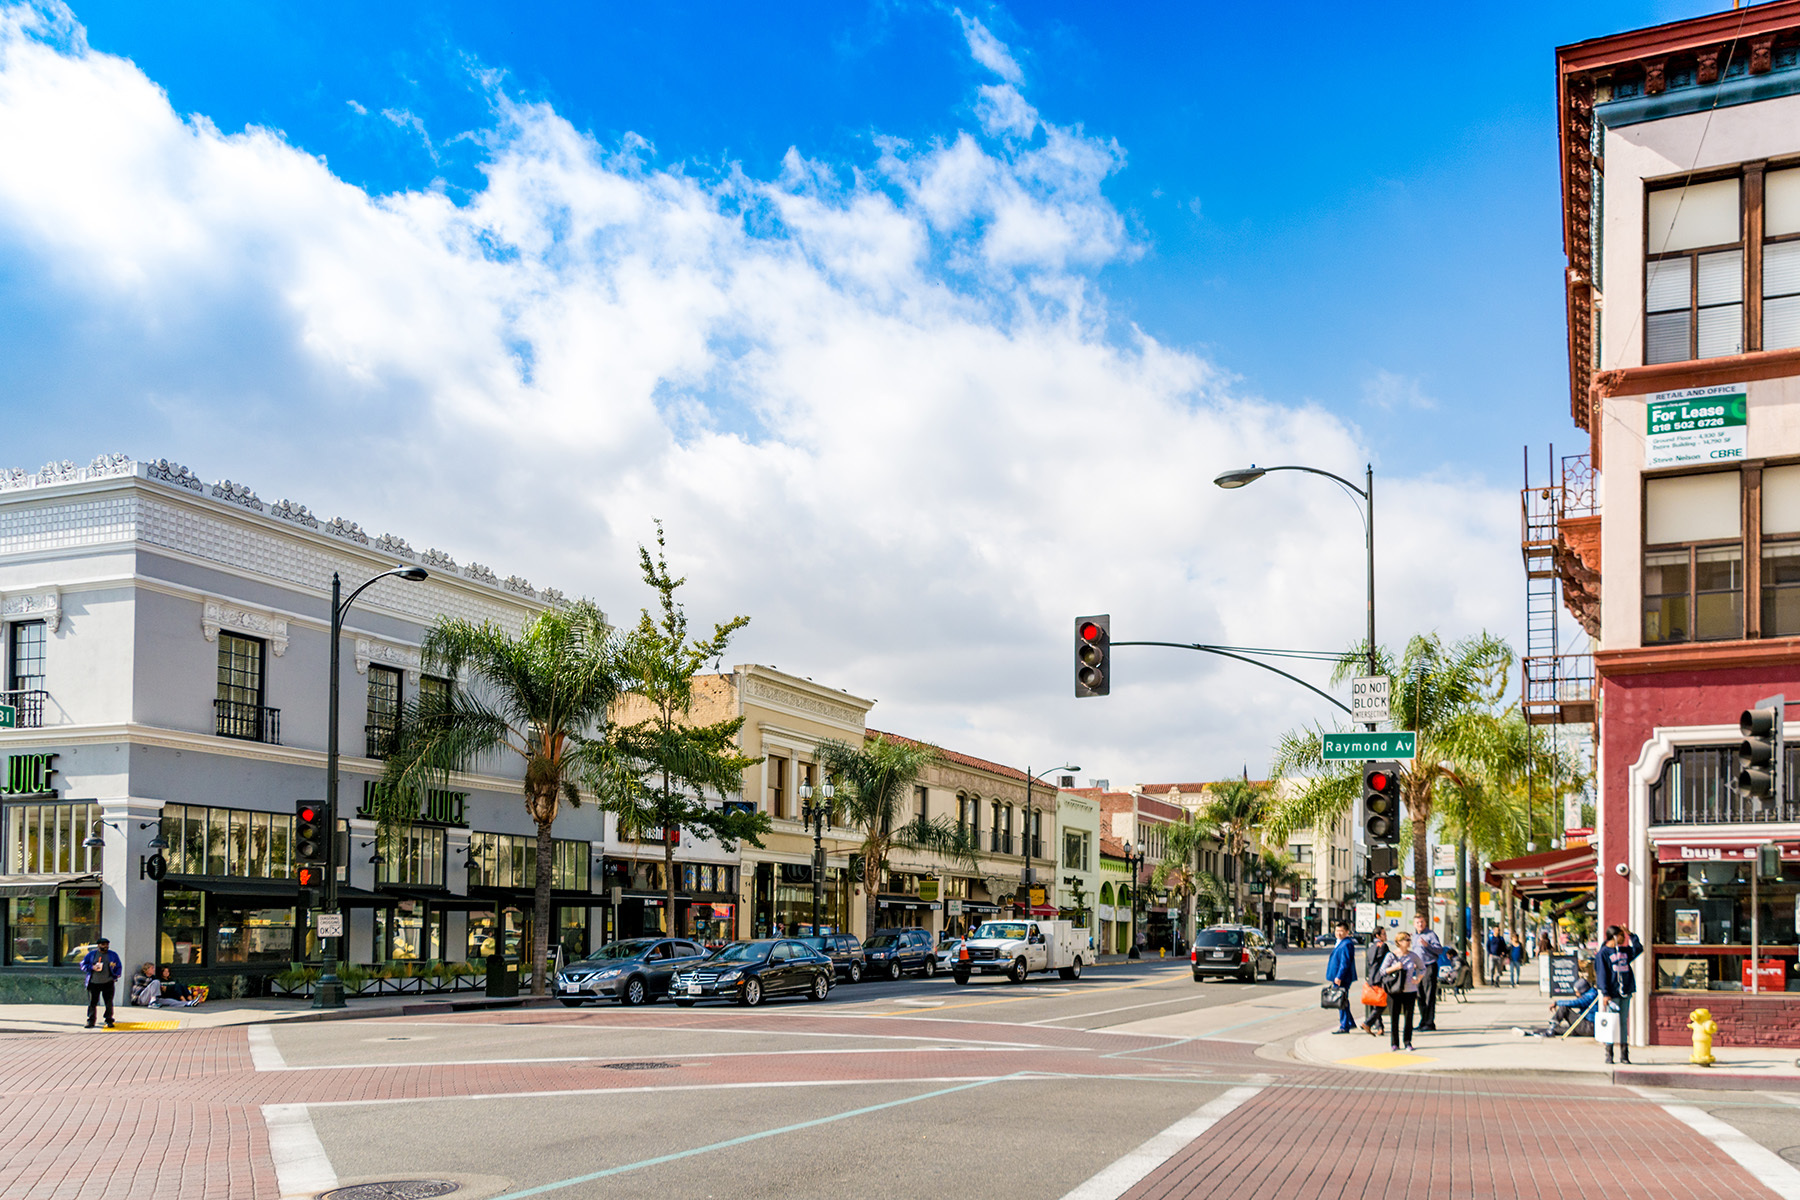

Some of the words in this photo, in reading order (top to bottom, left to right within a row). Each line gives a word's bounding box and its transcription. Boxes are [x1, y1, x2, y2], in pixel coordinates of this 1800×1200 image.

[1656, 391, 1684, 400] RETAIL
[1686, 389, 1705, 397] AND
[1707, 386, 1736, 394] OFFICE
[1652, 409, 1677, 422] For
[1681, 406, 1725, 419] Lease
[1652, 423, 1671, 432] 818
[1674, 421, 1695, 430] 502
[1697, 418, 1725, 427] 6726
[1709, 448, 1743, 459] CBRE
[1354, 683, 1367, 694] DO
[1369, 682, 1387, 692] NOT
[1354, 697, 1387, 708] BLOCK
[1354, 710, 1387, 718] INTERSECTION
[1325, 740, 1388, 754] Raymond
[1395, 740, 1413, 751] Av
[0, 753, 58, 794] JUICE
[421, 789, 471, 824] JUICE
[1681, 846, 1721, 860] buy
